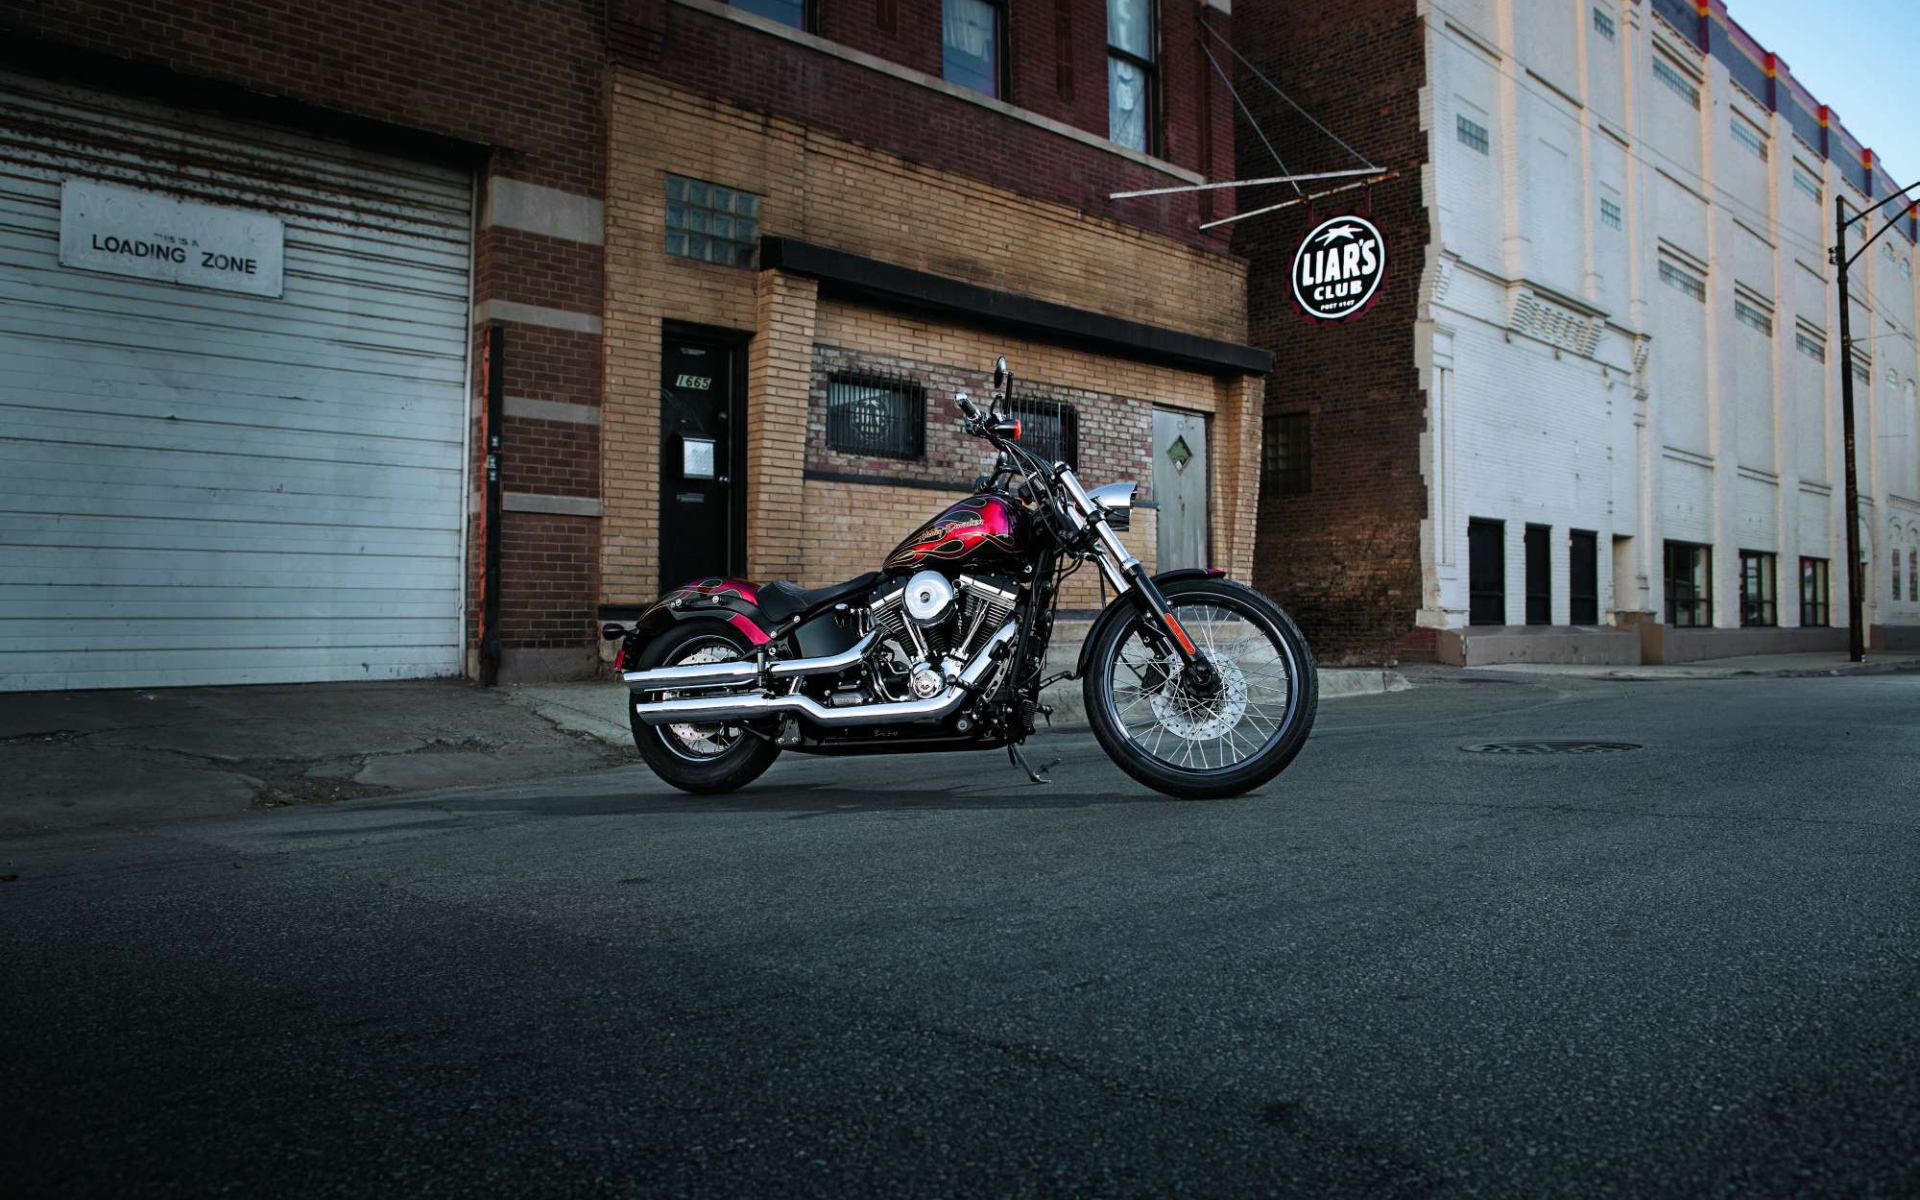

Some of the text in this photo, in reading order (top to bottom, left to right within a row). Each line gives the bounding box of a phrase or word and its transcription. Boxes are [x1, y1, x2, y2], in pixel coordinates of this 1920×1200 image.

[92, 233, 186, 264] LOADING
[201, 251, 258, 275] ZONE
[1303, 239, 1377, 286] LIAR'S
[1313, 280, 1362, 300] CLUB
[678, 375, 710, 389] 1665
